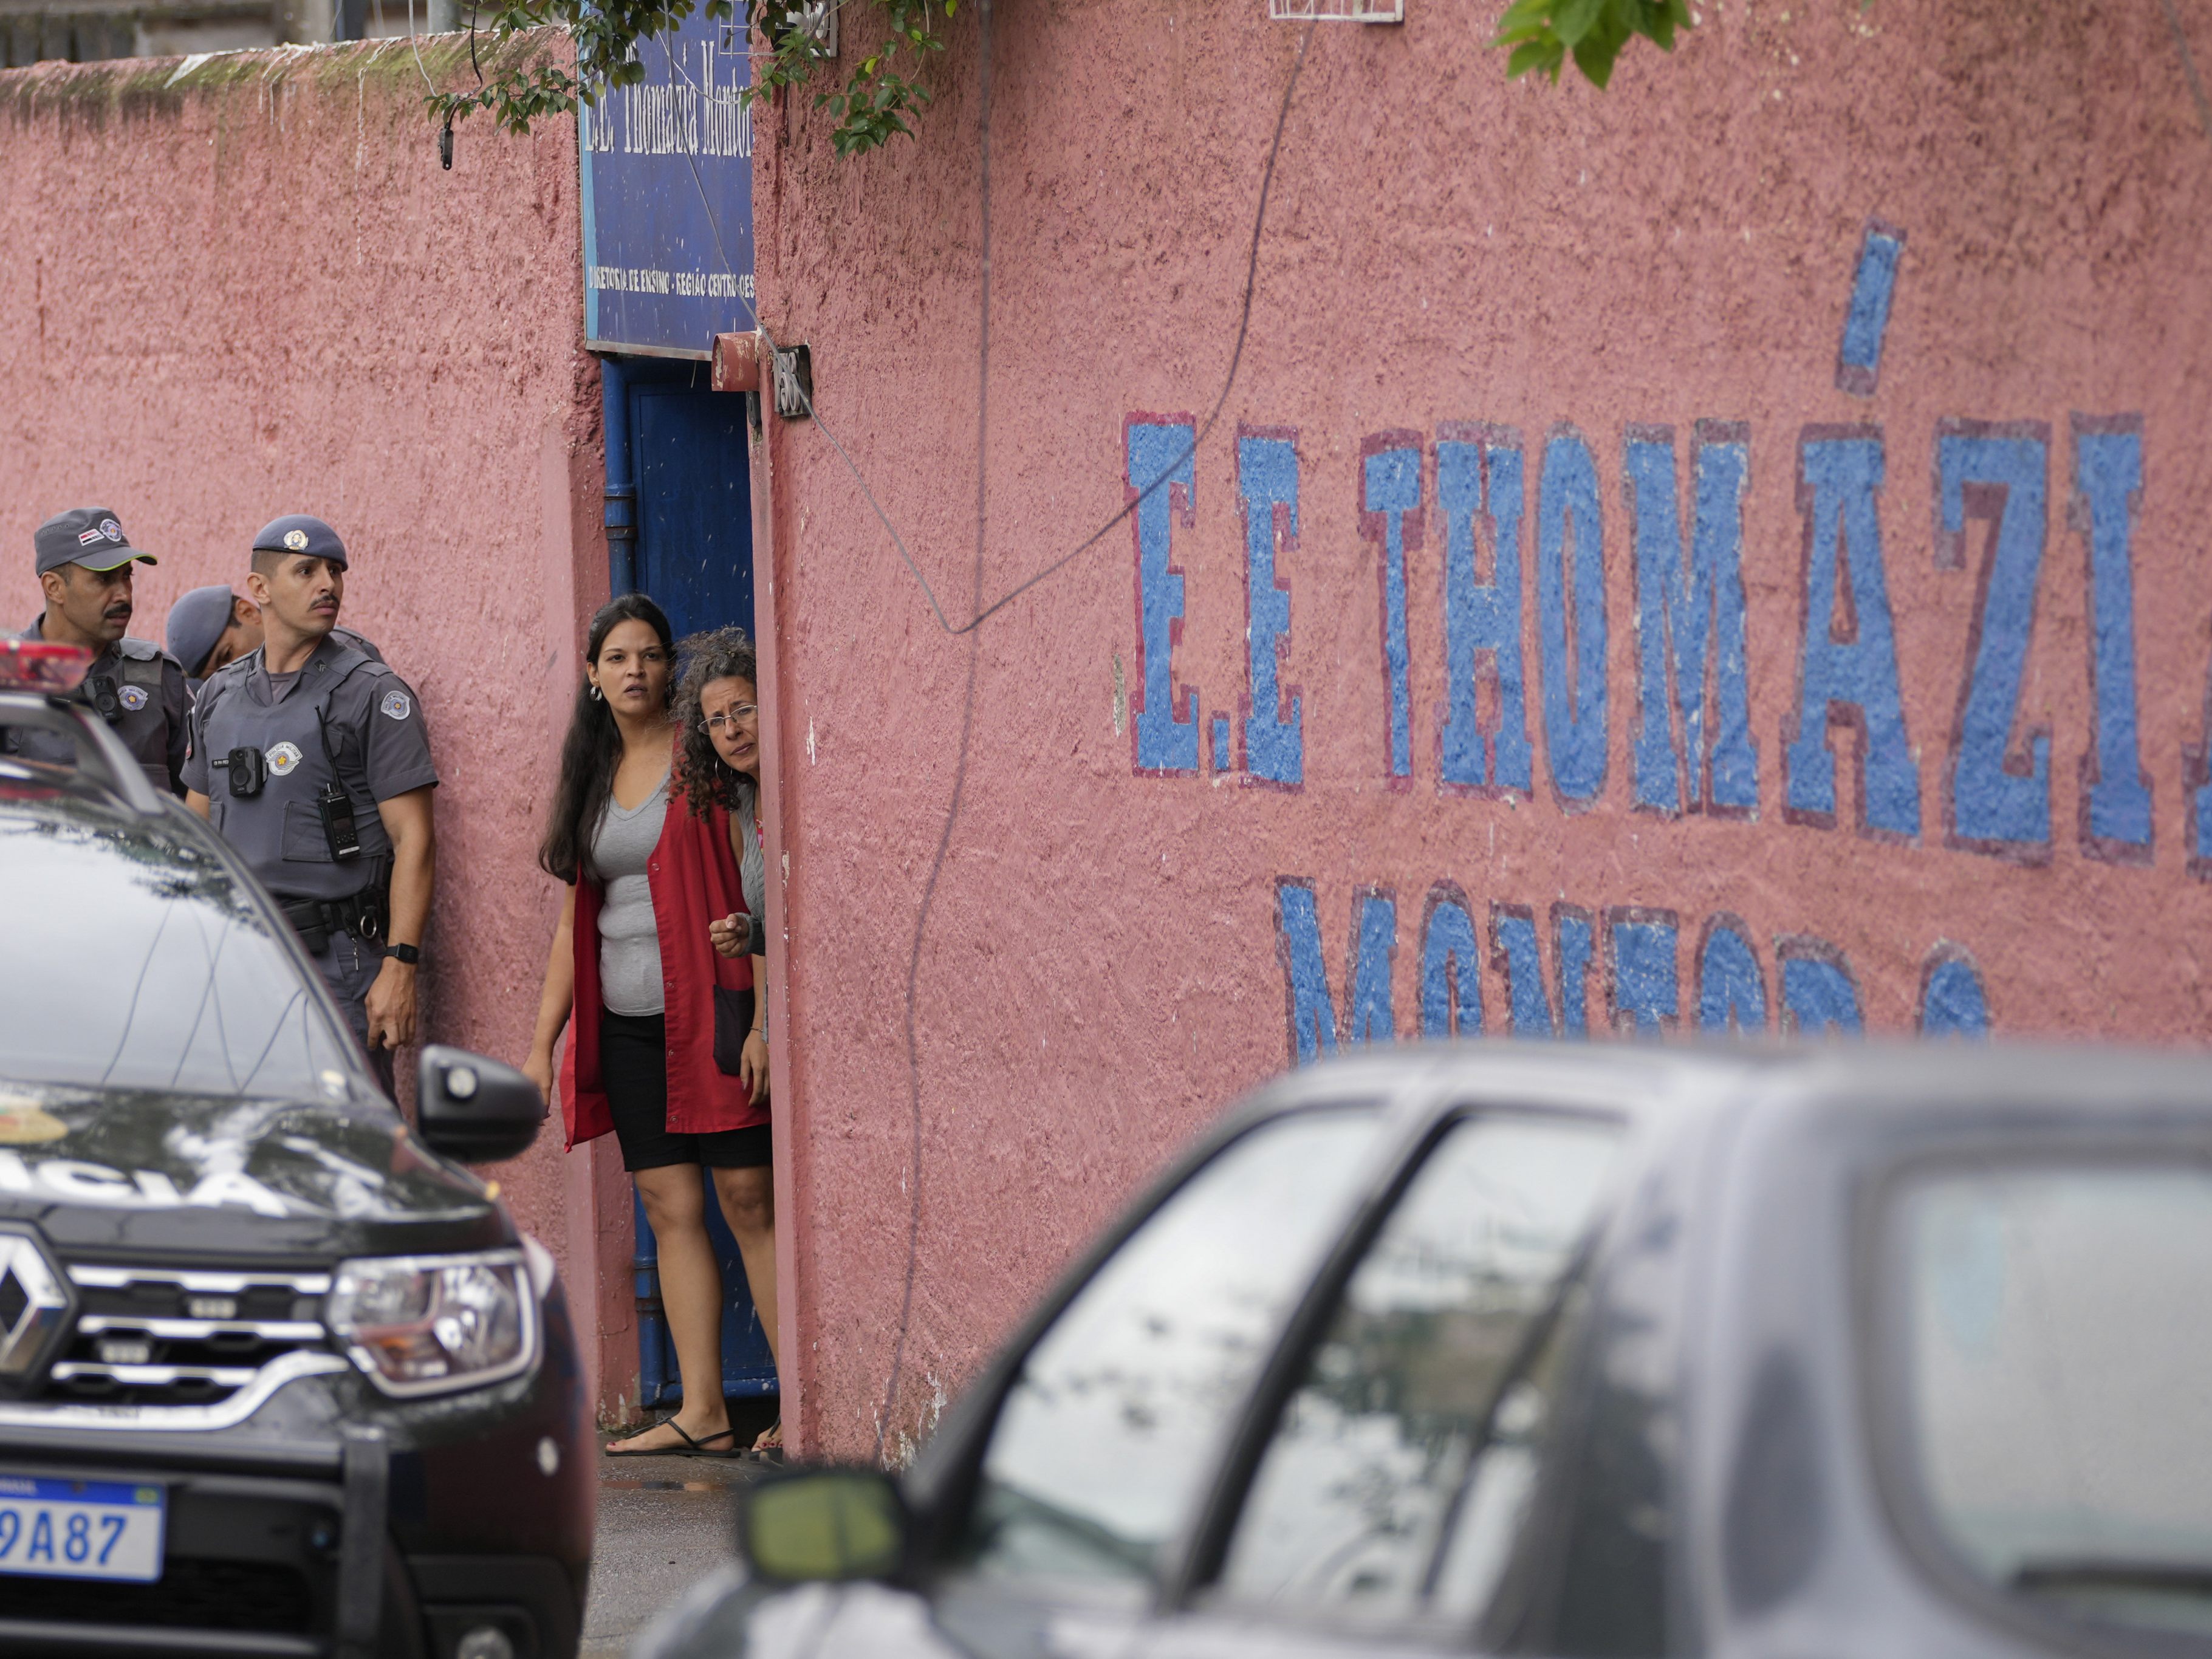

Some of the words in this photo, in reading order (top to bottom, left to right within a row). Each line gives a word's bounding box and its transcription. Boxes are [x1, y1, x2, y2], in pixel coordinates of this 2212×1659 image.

[589, 266, 628, 291] DIRETORIA
[629, 269, 640, 292] DE
[641, 269, 669, 295] ENSINO
[676, 268, 706, 296] REGIÃO
[1357, 216, 2212, 880] THOMÁZI
